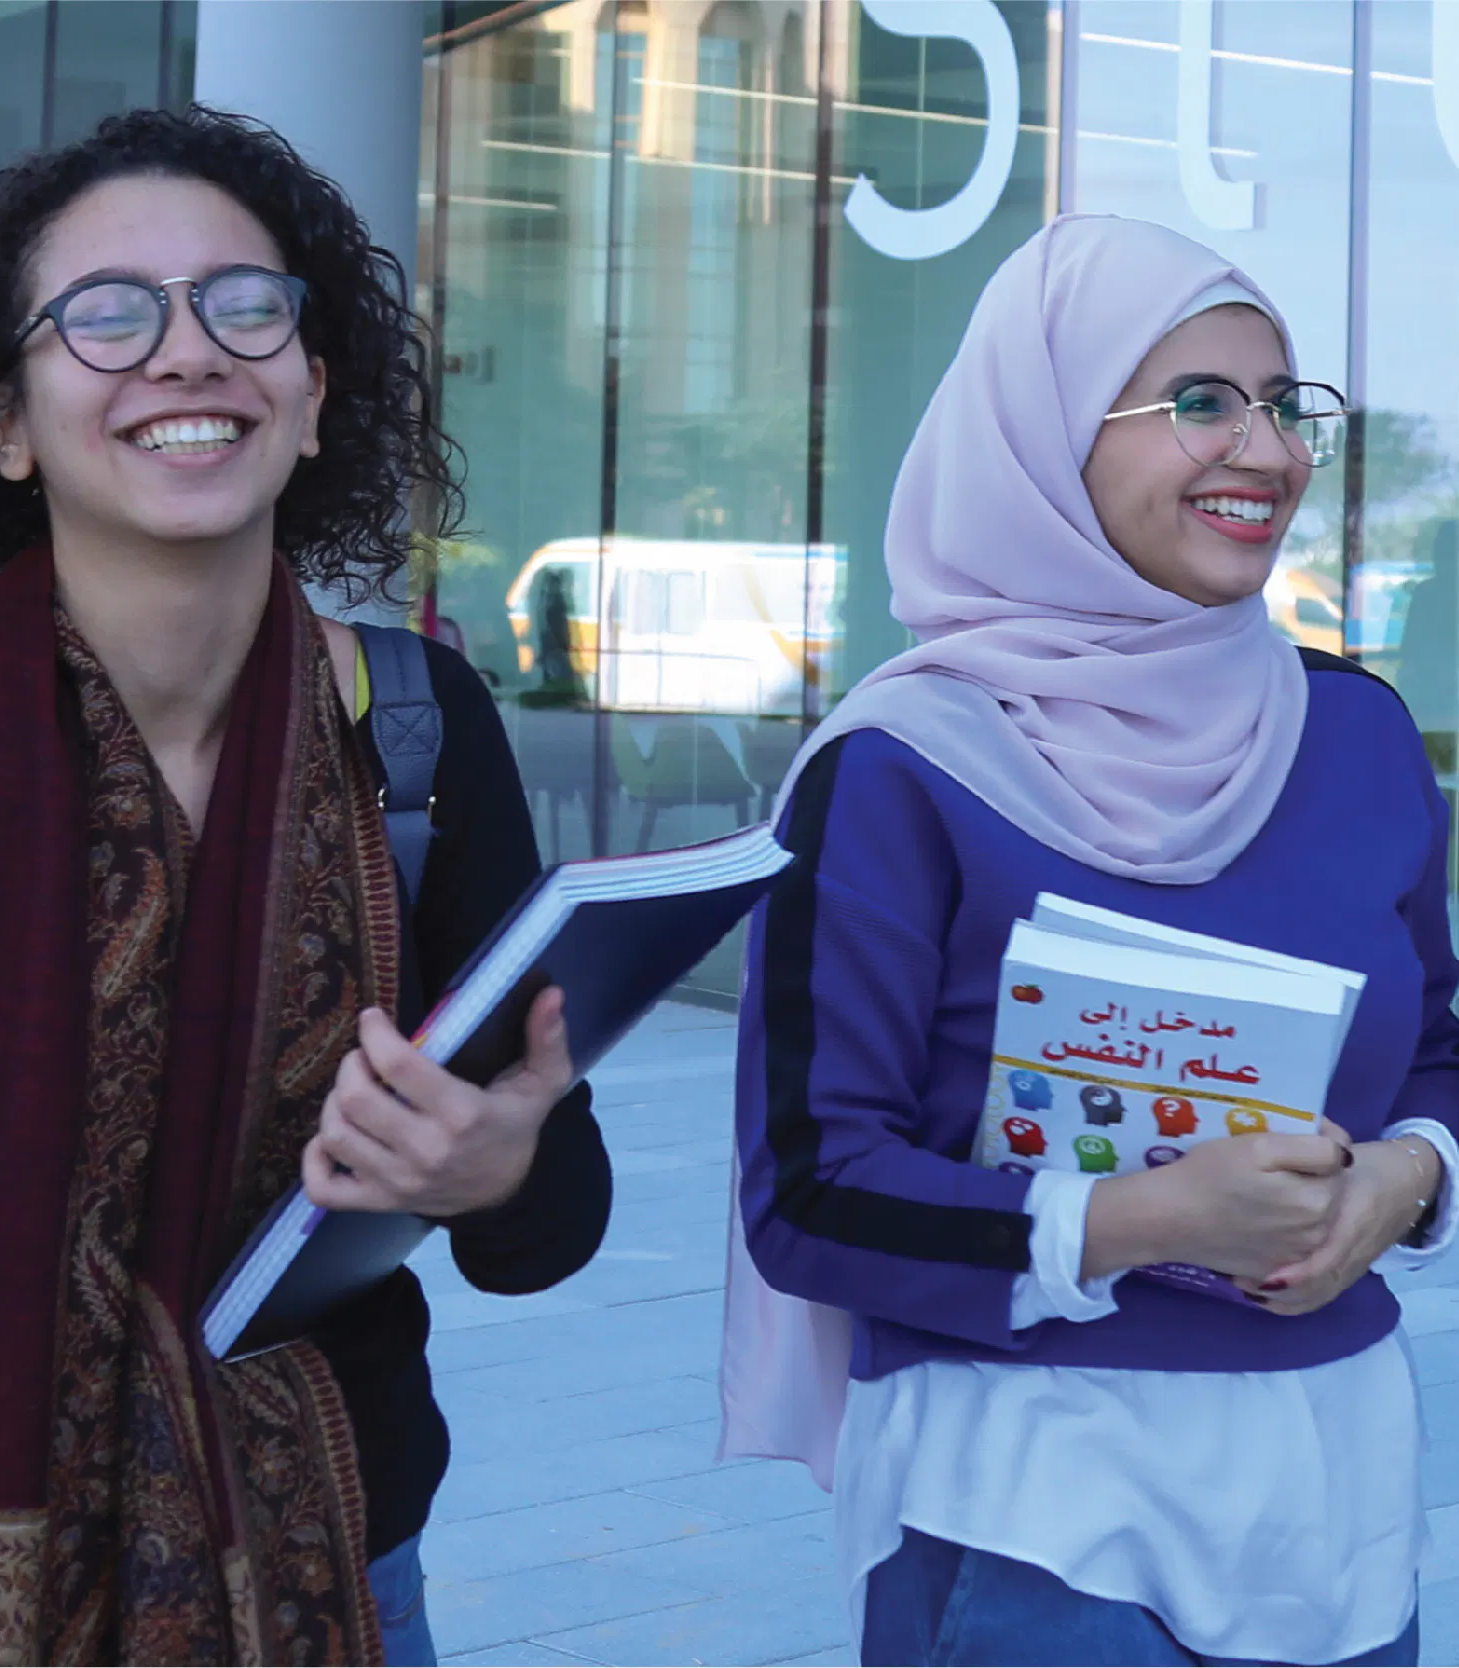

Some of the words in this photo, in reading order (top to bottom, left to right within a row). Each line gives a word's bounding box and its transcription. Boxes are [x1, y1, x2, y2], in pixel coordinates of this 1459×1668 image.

[1079, 1001, 1128, 1030] إلى
[1139, 1010, 1236, 1039] مدخل
[1041, 1033, 1163, 1069] النفس
[1179, 1053, 1260, 1084] علم
